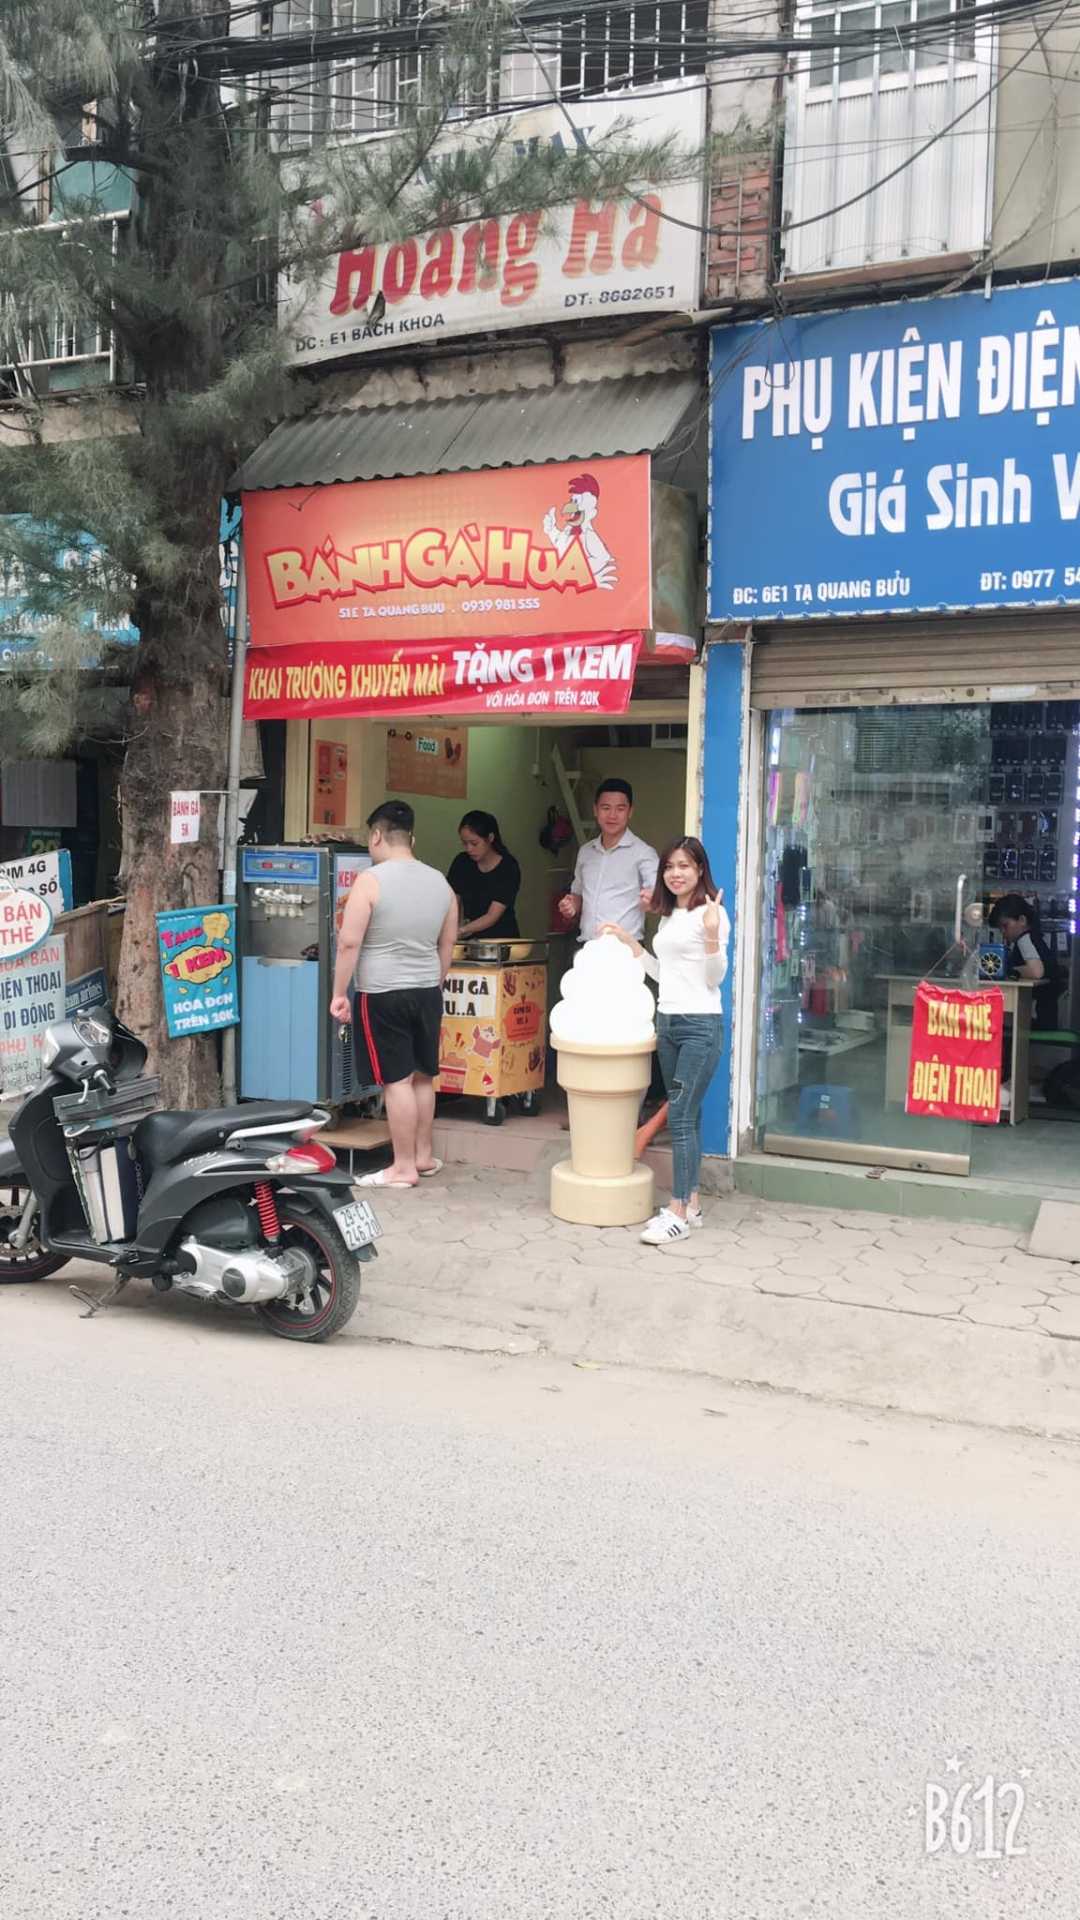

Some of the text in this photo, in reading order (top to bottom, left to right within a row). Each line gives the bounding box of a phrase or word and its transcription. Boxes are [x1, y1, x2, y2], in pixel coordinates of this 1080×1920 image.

[330, 330, 347, 345] E1
[399, 313, 445, 332] KHOA
[741, 356, 833, 451] PHỤ
[847, 326, 963, 441] KIỆN
[828, 468, 907, 537] Giá
[926, 457, 1032, 531] Sinh
[980, 571, 1007, 591] ĐT:
[1011, 568, 1055, 590] 0977
[732, 587, 758, 605] ĐC:
[762, 585, 788, 604] 6E1
[793, 583, 813, 605] TẠ
[817, 580, 871, 602] QUANG
[378, 604, 420, 618] QUANG
[461, 599, 494, 613] 0939
[248, 666, 283, 700] KHAI
[286, 660, 347, 699] TRƯƠNG
[350, 648, 410, 698] KHUYẾN
[453, 642, 535, 693] TẶNG
[527, 689, 549, 706] ĐƠN
[554, 687, 578, 706] TRÊN
[579, 690, 600, 706] 20K
[417, 737, 437, 752] Food
[28, 860, 47, 875] 4G
[3, 900, 43, 923] BÁN
[30, 943, 60, 966] BÁN
[0, 976, 23, 1004] IỆN
[25, 970, 62, 995] THOẠI
[467, 976, 489, 996] GÀ
[4, 1001, 56, 1031] DI ĐỘNG
[927, 995, 960, 1038] BÁN
[912, 1053, 998, 1118] ĐIỆN THOẠI
